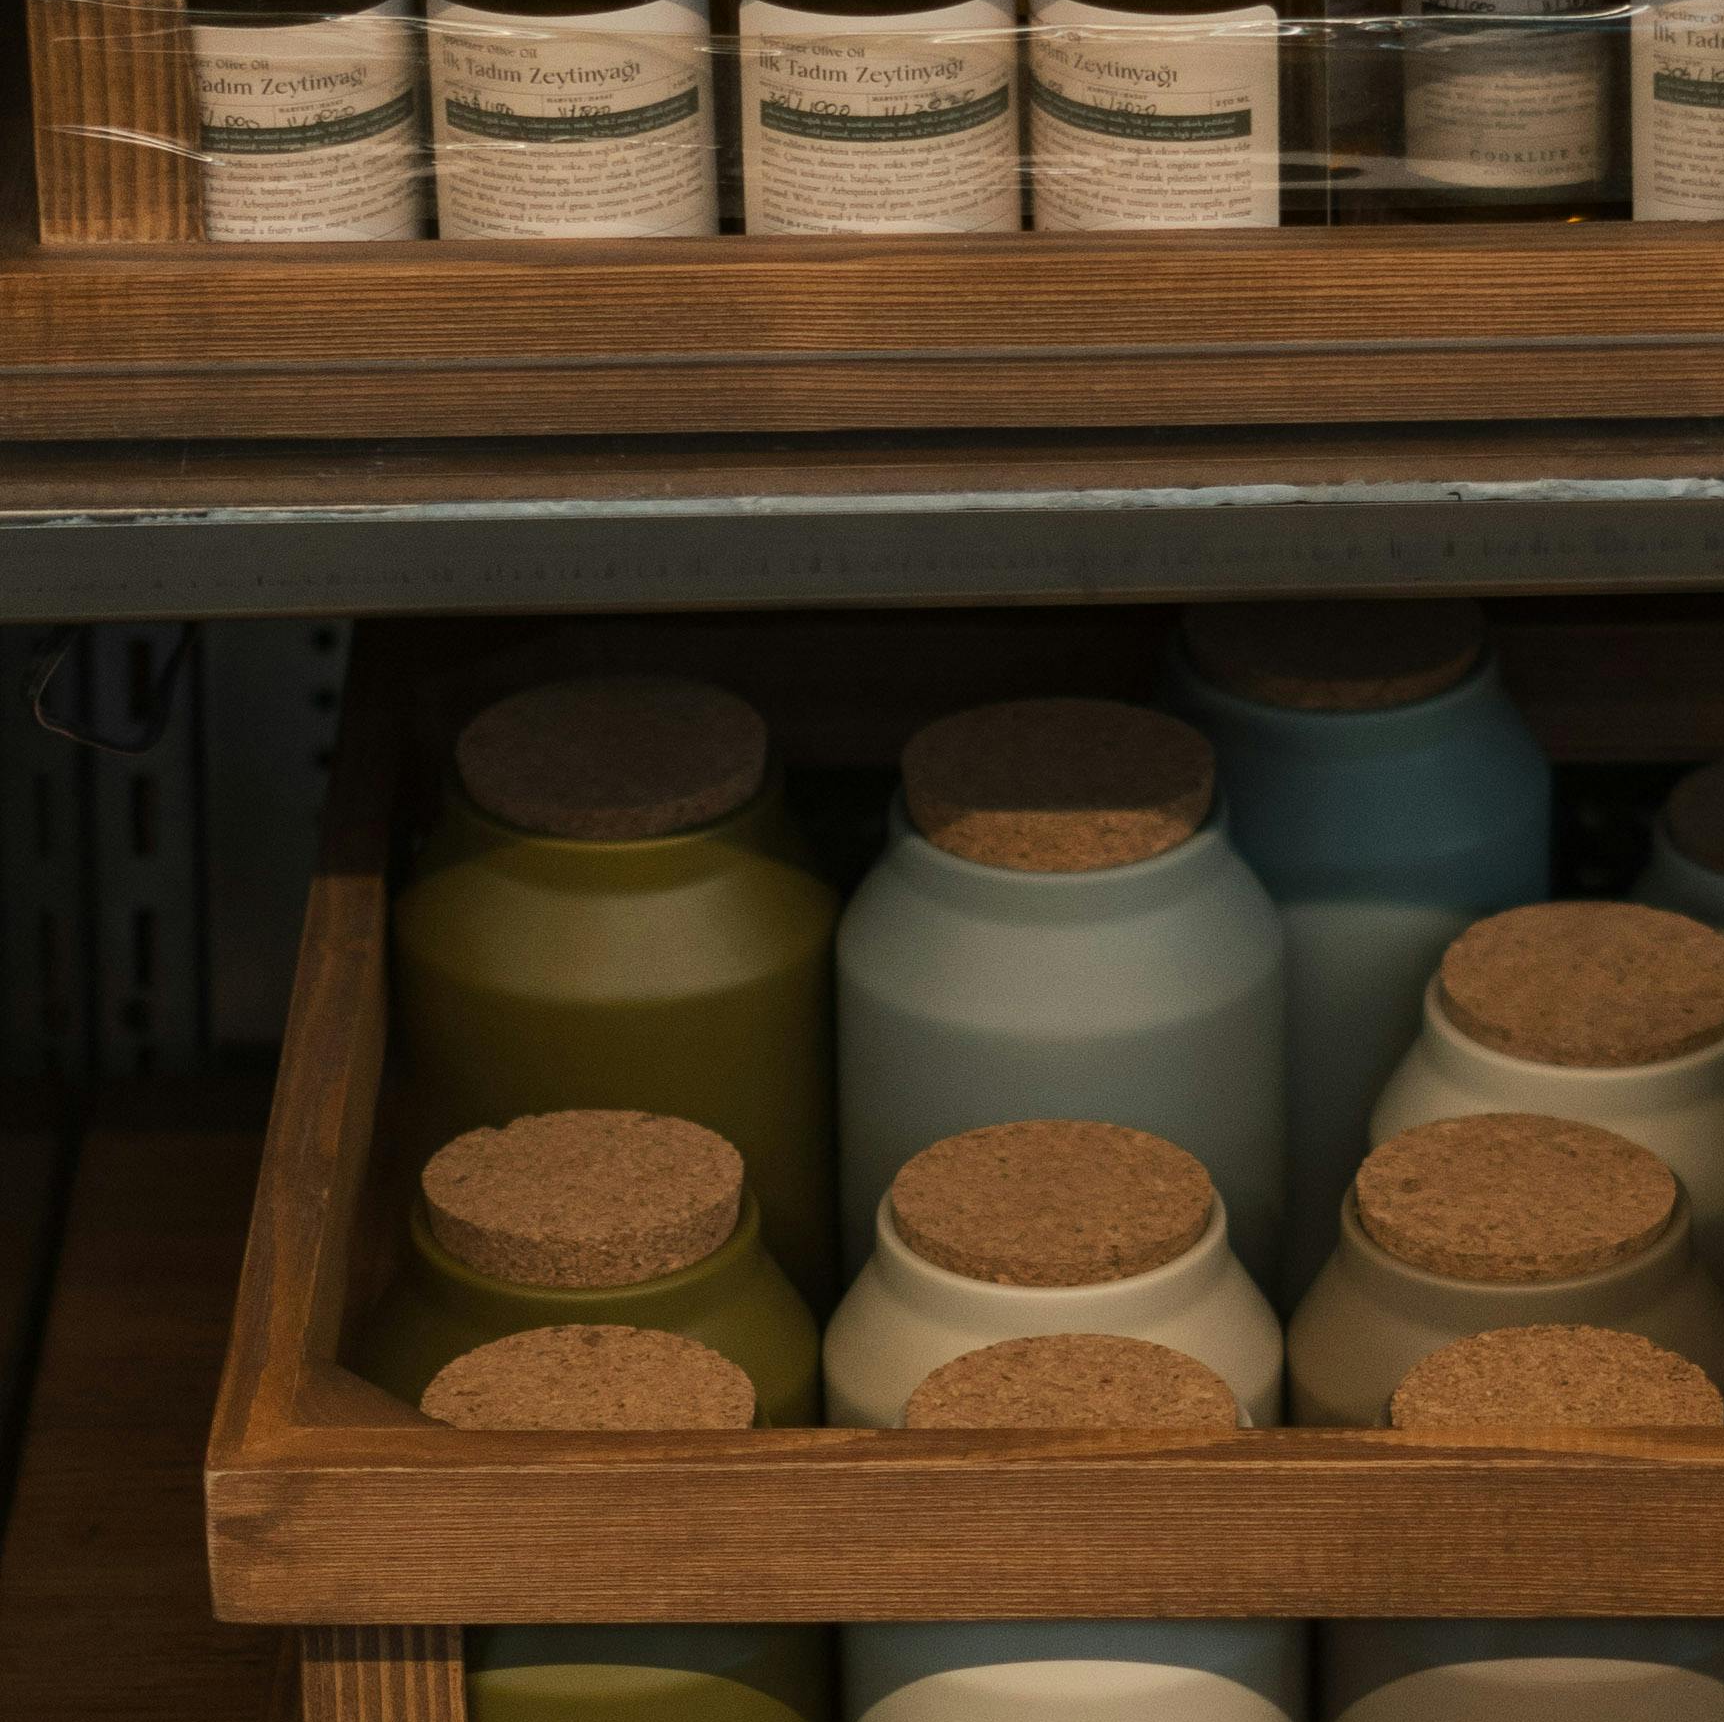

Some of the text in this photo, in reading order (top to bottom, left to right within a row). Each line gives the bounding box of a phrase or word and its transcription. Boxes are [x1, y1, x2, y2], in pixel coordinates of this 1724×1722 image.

[197, 66, 368, 99] adım Zeytinyağı
[464, 55, 523, 83] Tadım
[529, 59, 642, 89] Zeytinyağı
[786, 58, 848, 84] Tadım
[855, 56, 966, 88] Zeytinyağı
[1073, 50, 1179, 89] Zeytinyağı
